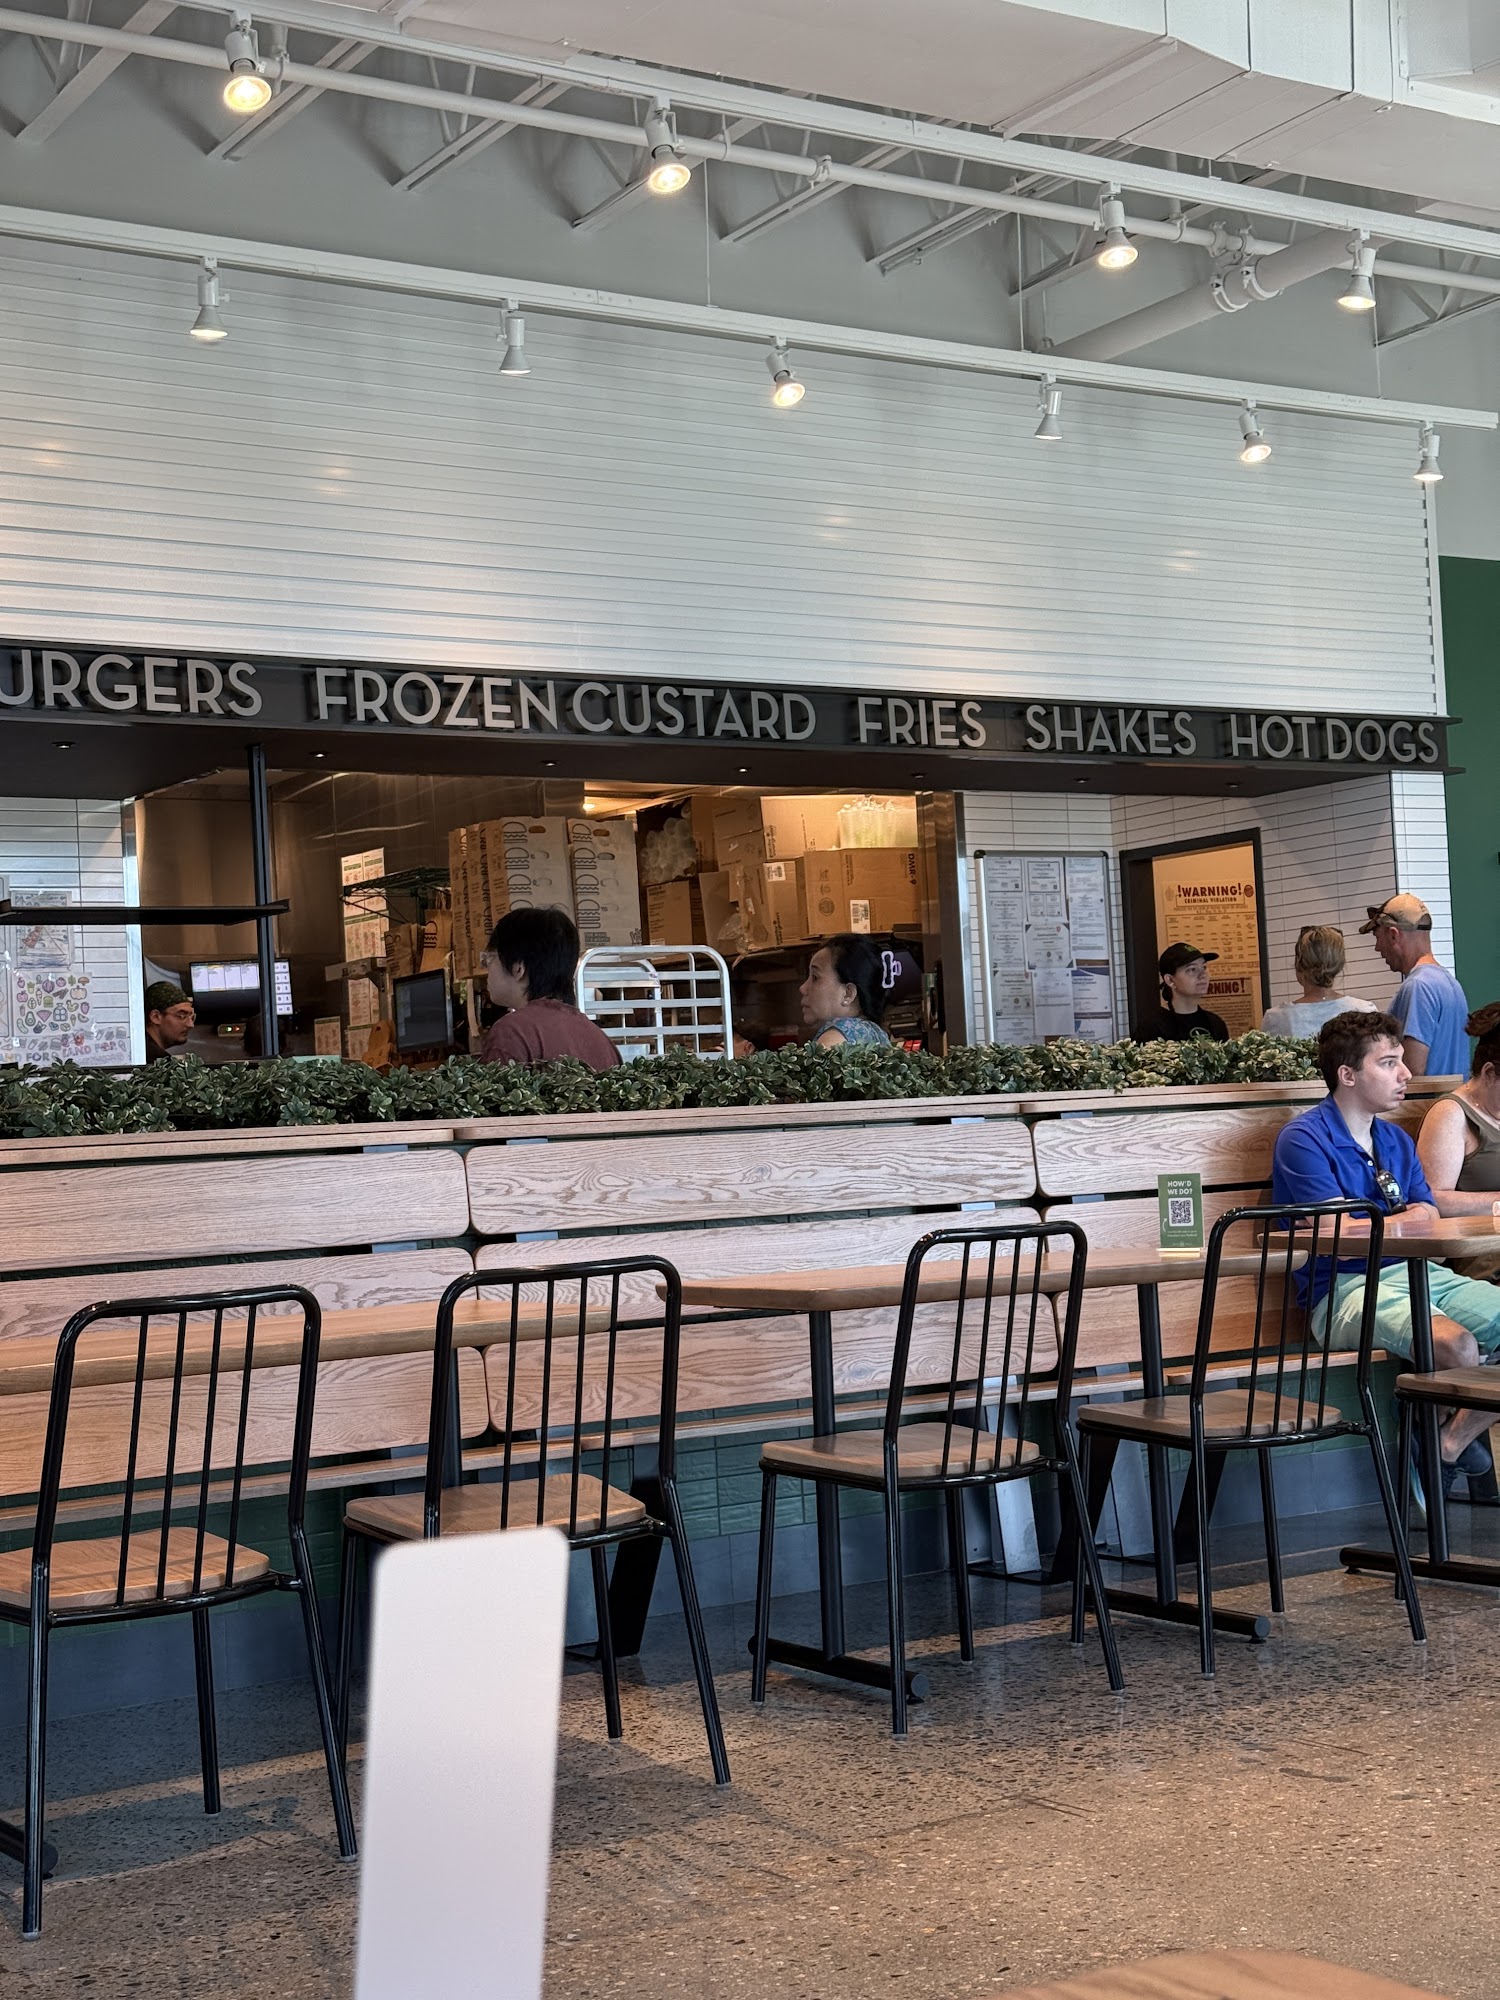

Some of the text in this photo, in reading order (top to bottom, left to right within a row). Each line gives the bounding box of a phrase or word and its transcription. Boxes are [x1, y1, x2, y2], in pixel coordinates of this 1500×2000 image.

[0, 649, 263, 717] URGERS
[315, 667, 817, 742] FROZEN CUSTARD
[857, 696, 987, 748] FRIES
[1026, 704, 1197, 756] SHAKES
[1230, 714, 1439, 764] HOT DOGS
[907, 853, 917, 885] DMR-9
[1207, 978, 1245, 995] RNING!
[1167, 1180, 1192, 1188] HOW'D
